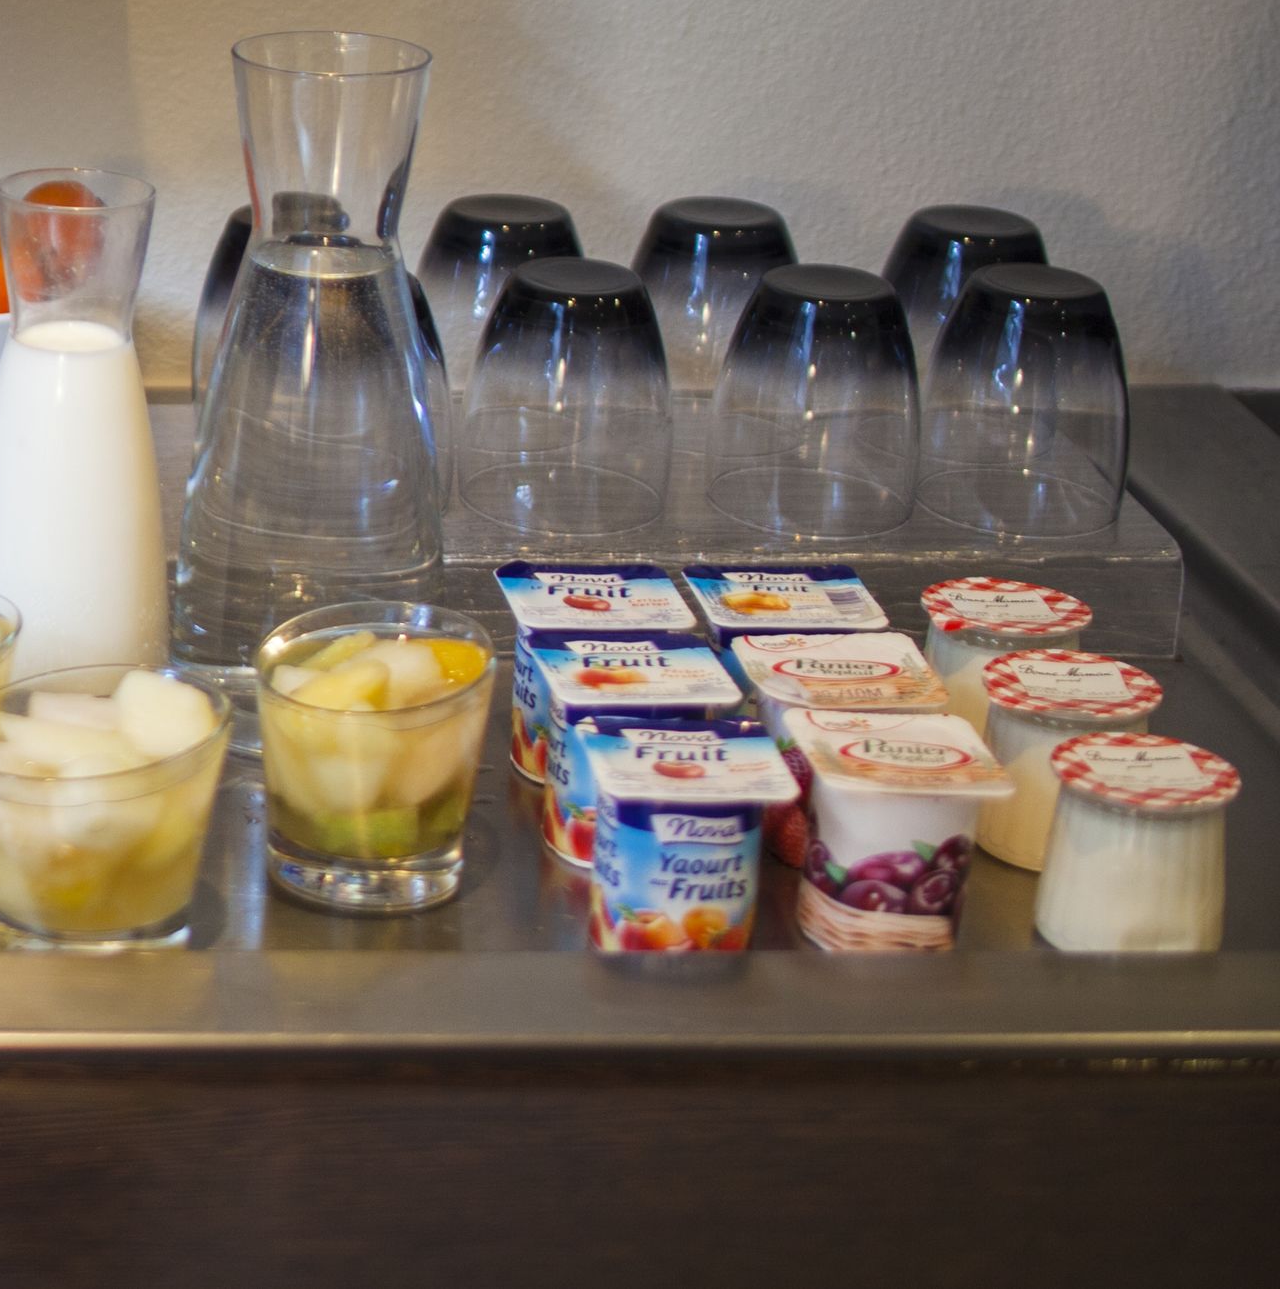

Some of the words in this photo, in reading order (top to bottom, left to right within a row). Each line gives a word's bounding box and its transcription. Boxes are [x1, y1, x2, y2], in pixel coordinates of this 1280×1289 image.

[547, 584, 632, 598] Fruit
[752, 584, 810, 593] Fruit
[581, 655, 671, 668] Fruit
[796, 658, 873, 670] Panier
[635, 745, 729, 762] Fruit
[864, 738, 945, 755] Panier
[665, 815, 739, 839] Nova
[659, 850, 744, 875] Yaourt
[668, 874, 747, 902] Fruits
